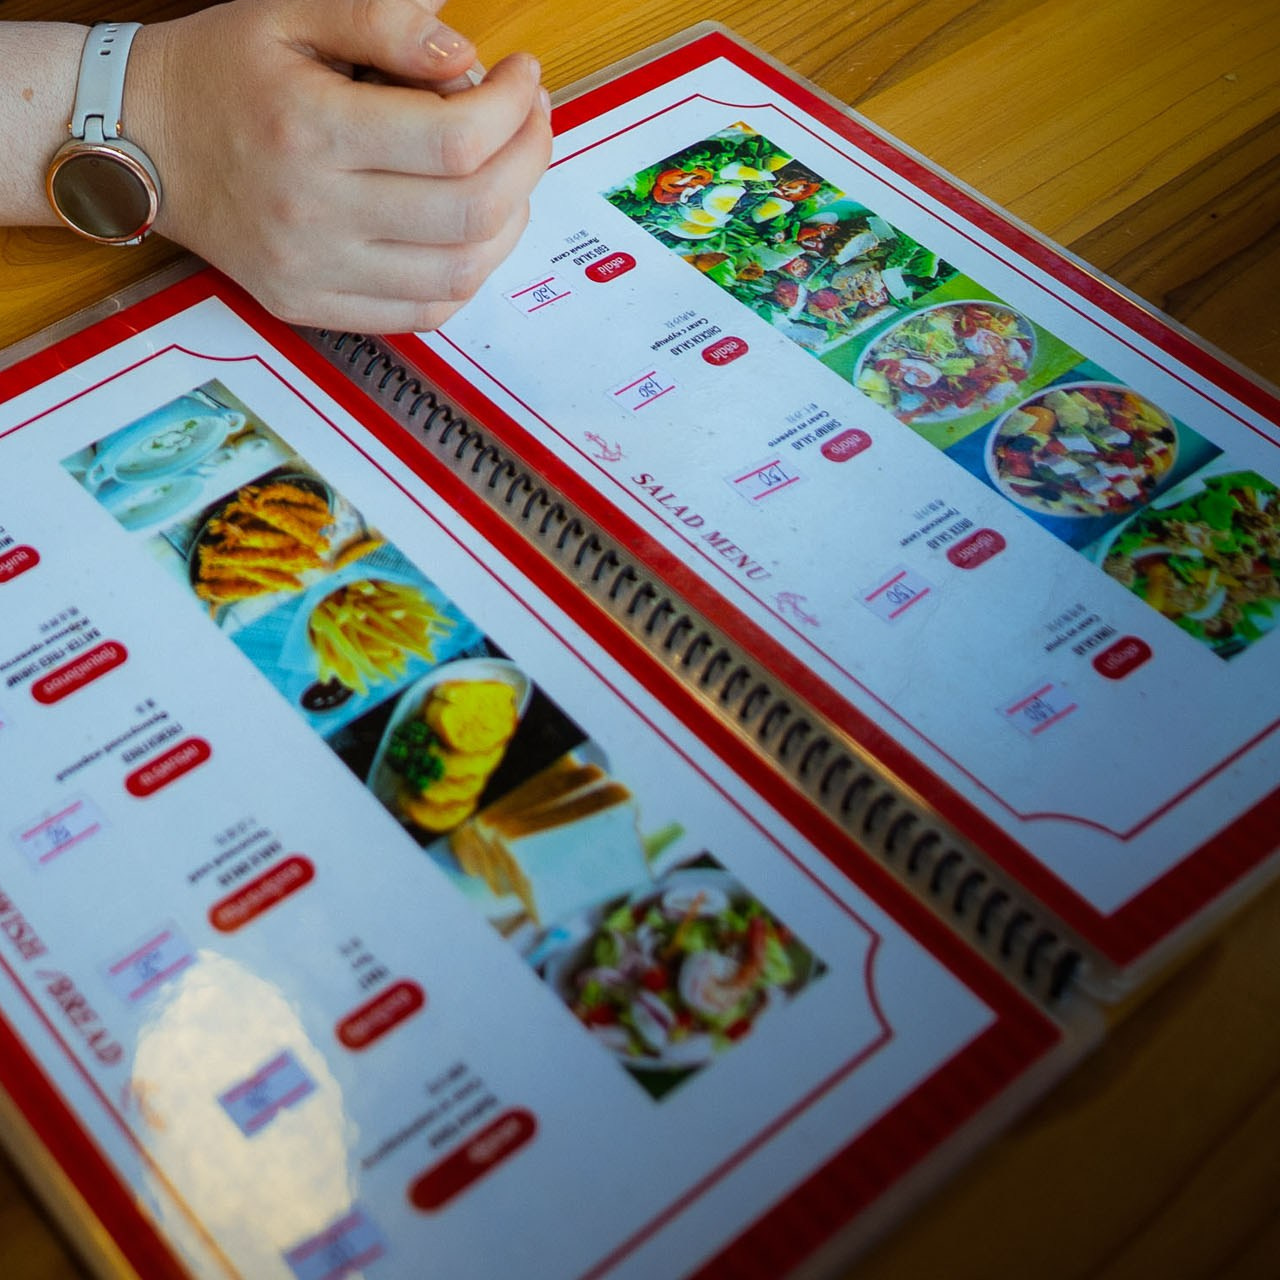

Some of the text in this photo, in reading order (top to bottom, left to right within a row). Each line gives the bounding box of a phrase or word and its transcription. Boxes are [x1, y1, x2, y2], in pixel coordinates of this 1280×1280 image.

[549, 250, 570, 263] салат
[572, 243, 609, 265] EGG SALAD
[531, 283, 556, 304] 120
[686, 316, 708, 331] Салат
[649, 330, 681, 352] курицей
[669, 324, 721, 356] CHICKEN SALAD
[790, 418, 842, 450] SHRIMP SALAD
[630, 471, 772, 581] SALAD MENU
[925, 530, 952, 550] SALAD
